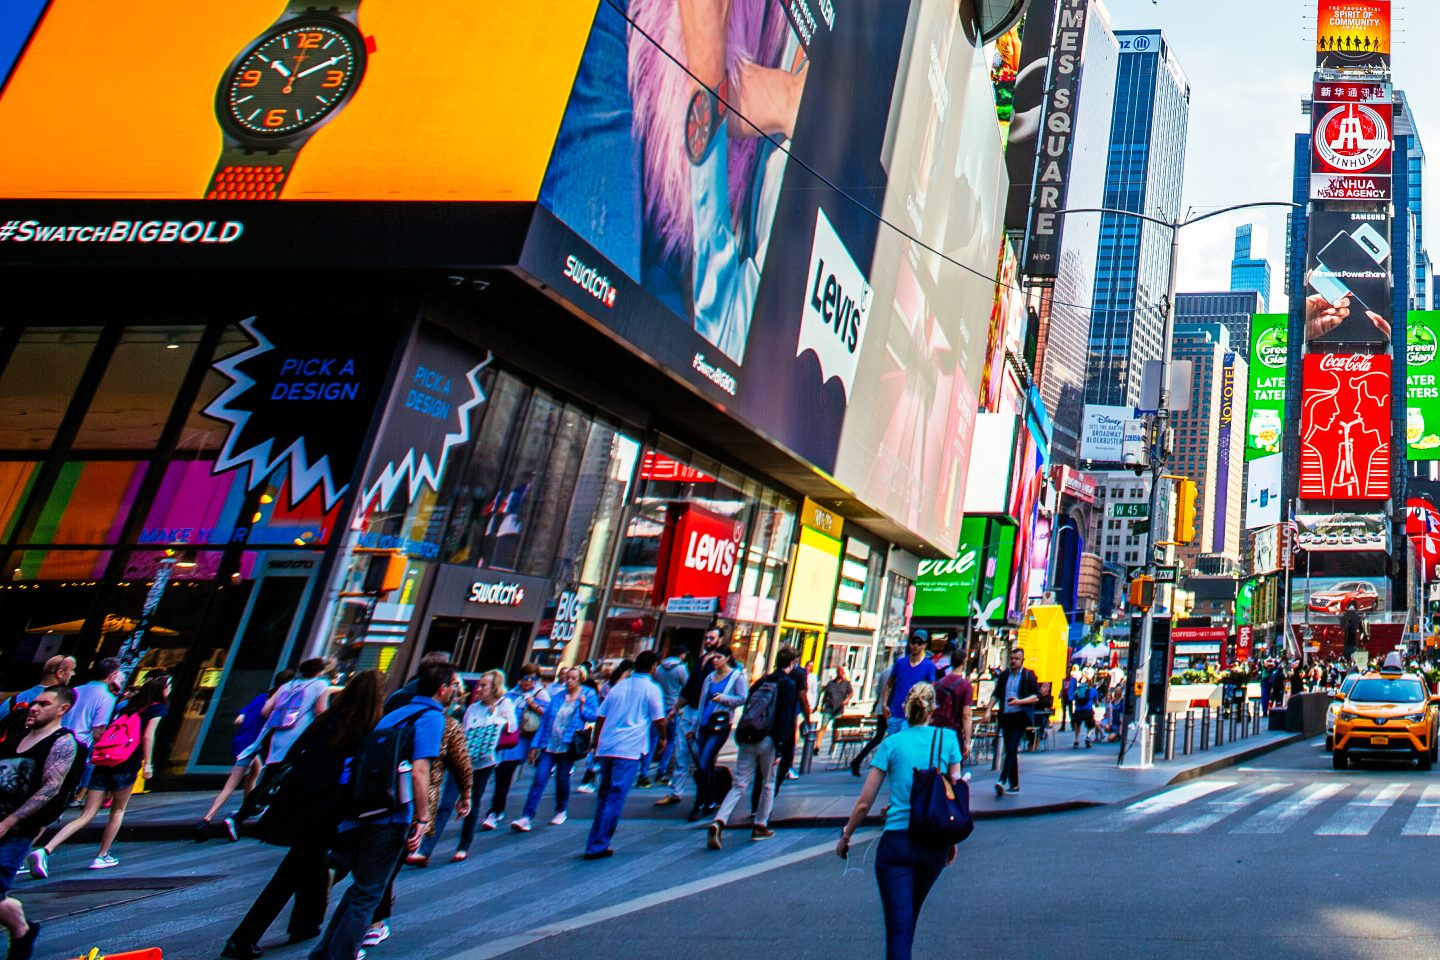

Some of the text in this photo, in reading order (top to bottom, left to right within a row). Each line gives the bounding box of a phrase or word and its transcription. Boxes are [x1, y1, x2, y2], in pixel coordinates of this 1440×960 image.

[1334, 10, 1373, 19] SPIRIT OF
[1329, 18, 1380, 27] COMMUNITY
[296, 33, 323, 49] 12
[238, 70, 344, 87] 9 3
[263, 109, 288, 126] 6
[1036, 87, 1072, 236] SQUARE
[1329, 154, 1376, 169] XINHUA
[1328, 179, 1376, 190] XINHUA
[1345, 189, 1386, 198] AGENCY
[1350, 213, 1386, 221] SAMSUNG
[1032, 253, 1051, 261] NYC
[563, 254, 610, 303] swatch
[1341, 268, 1387, 279] PowerShare
[1261, 345, 1288, 356] Gree
[280, 358, 355, 377] PICK A
[1320, 352, 1375, 373] Coca-Cola
[413, 364, 441, 392] PICK
[1256, 377, 1287, 388] LATE
[1406, 375, 1436, 386] ATER
[270, 382, 361, 402] DESIGN
[1220, 365, 1236, 429] NOVOTEL
[1406, 388, 1440, 399] ATERS
[404, 390, 452, 421] DESIGN
[1091, 430, 1121, 438] BROADWAY
[1115, 504, 1124, 515] W
[1127, 504, 1138, 515] 45
[469, 580, 515, 604] swatch
